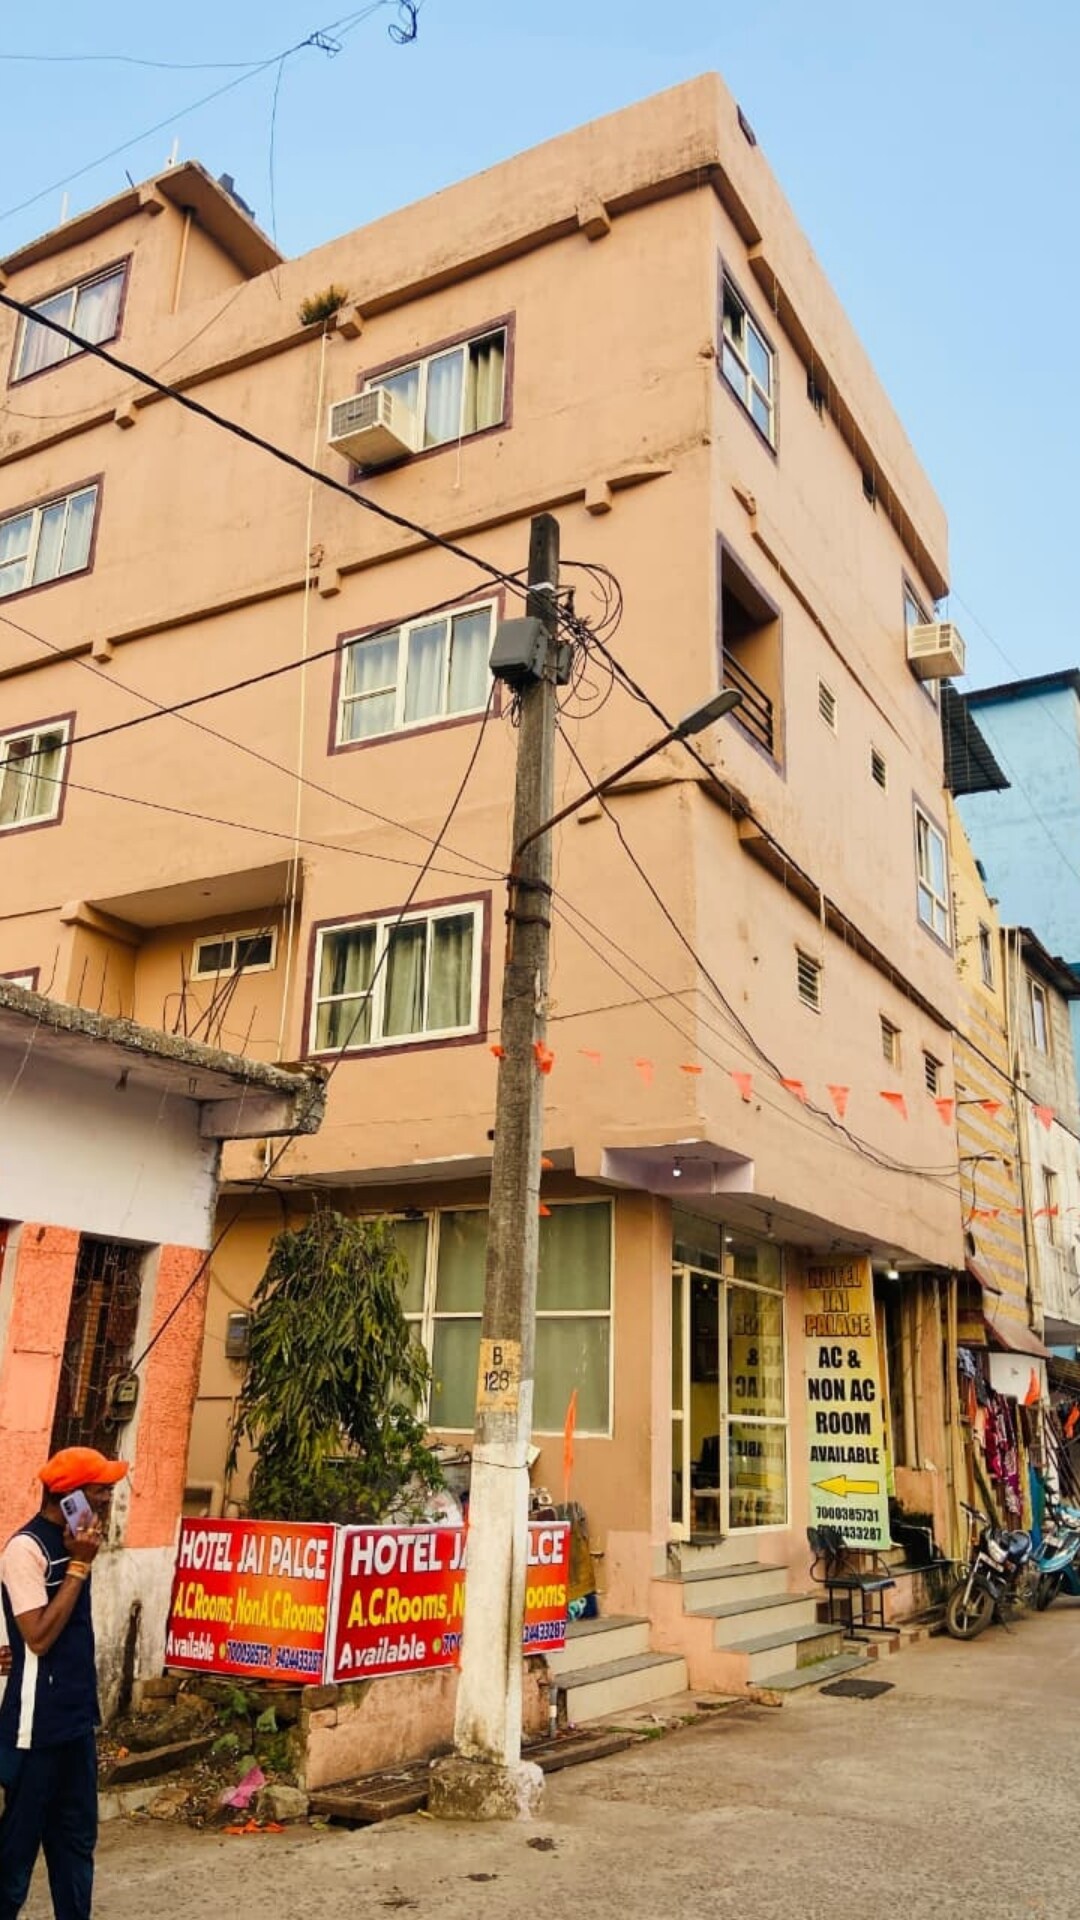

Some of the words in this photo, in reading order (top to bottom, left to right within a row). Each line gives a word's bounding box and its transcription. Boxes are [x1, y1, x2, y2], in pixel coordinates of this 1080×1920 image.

[805, 1314, 870, 1337] PALACE
[493, 1346, 503, 1365] B
[819, 1346, 842, 1368] AC
[848, 1350, 861, 1368] &
[484, 1370, 510, 1391] 128
[808, 1378, 846, 1400] NON
[851, 1379, 875, 1401] AC
[816, 1411, 871, 1435] ROOM
[810, 1446, 879, 1465] AVAILABLE
[816, 1506, 879, 1522] 7000385731
[180, 1530, 233, 1572] HOTEL
[237, 1534, 265, 1574] JAI
[269, 1536, 328, 1580] PALCE
[351, 1533, 442, 1576] HOTEL
[527, 1529, 565, 1566] LCE
[166, 1630, 215, 1662] Available
[338, 1633, 426, 1671] Available
